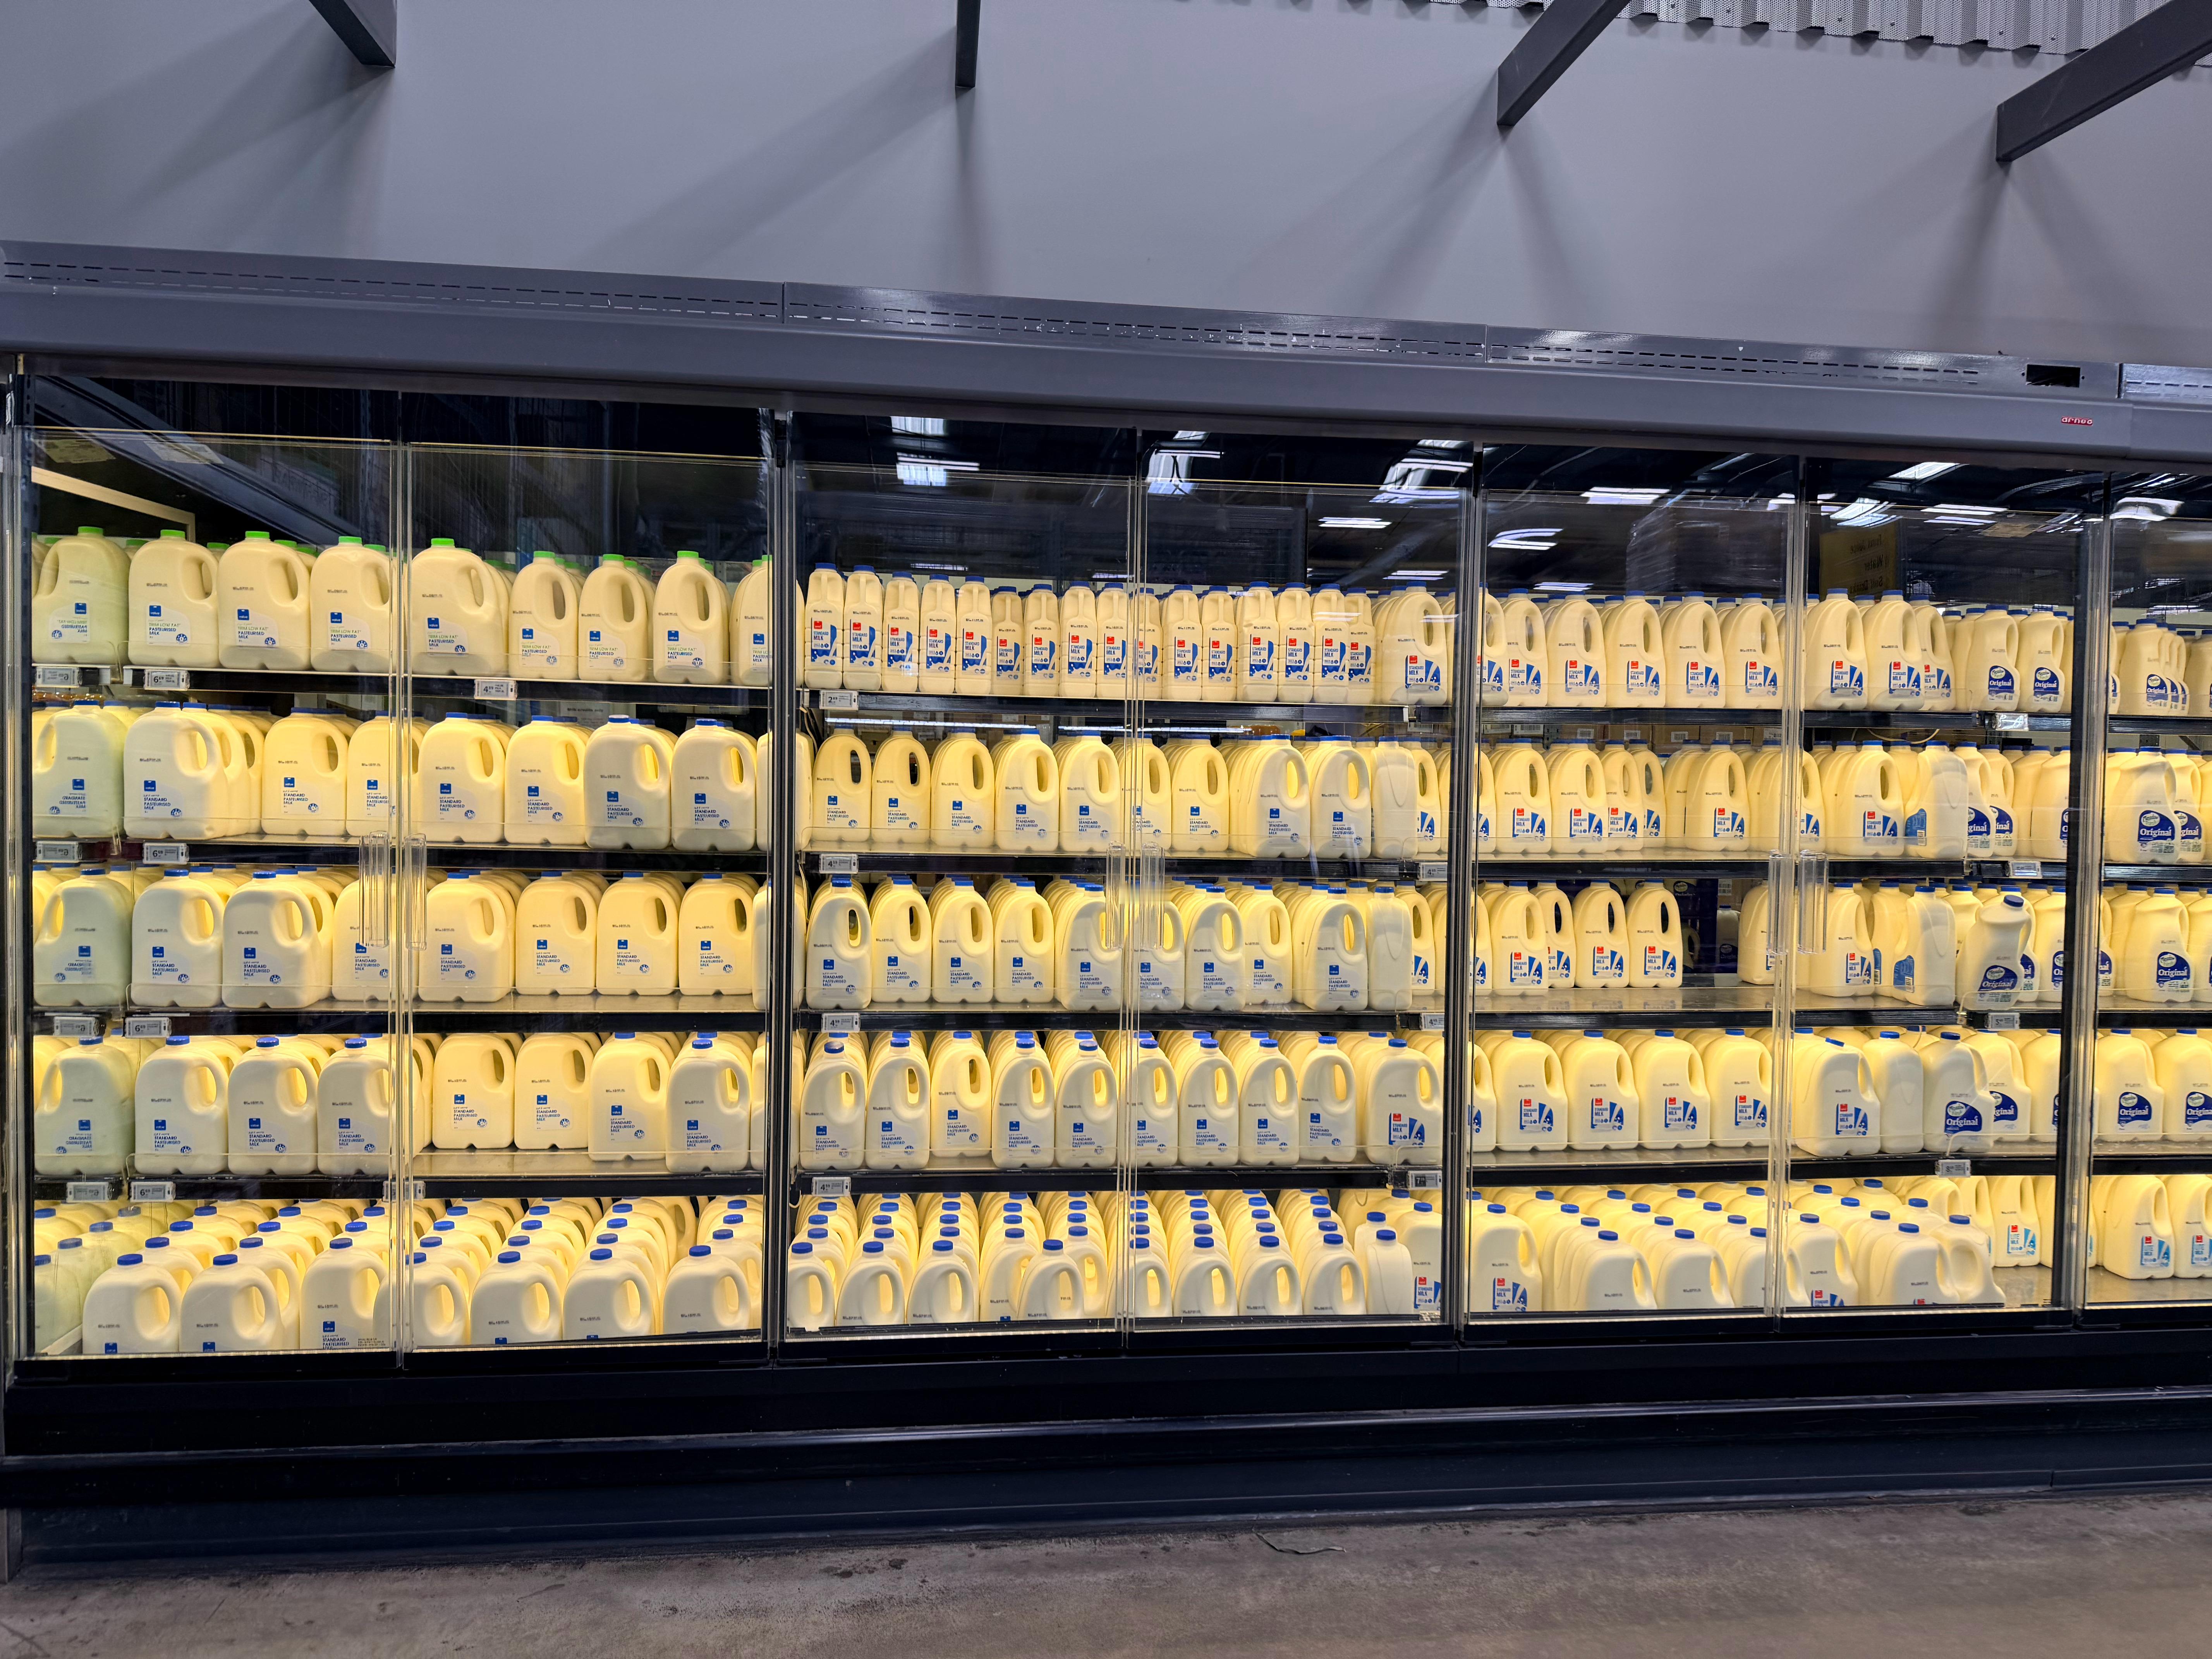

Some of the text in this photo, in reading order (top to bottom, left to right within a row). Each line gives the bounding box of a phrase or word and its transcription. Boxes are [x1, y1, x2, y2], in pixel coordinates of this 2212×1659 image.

[2035, 681, 2057, 689] Original
[1968, 822, 1987, 832] ginal
[2140, 826, 2171, 836] Original
[2181, 826, 2198, 836] ginal
[2158, 968, 2187, 977] Original
[1982, 979, 2014, 988] Original
[2119, 1106, 2148, 1116] Original
[2187, 1108, 2212, 1116] Origina
[1946, 1116, 1978, 1127] Original
